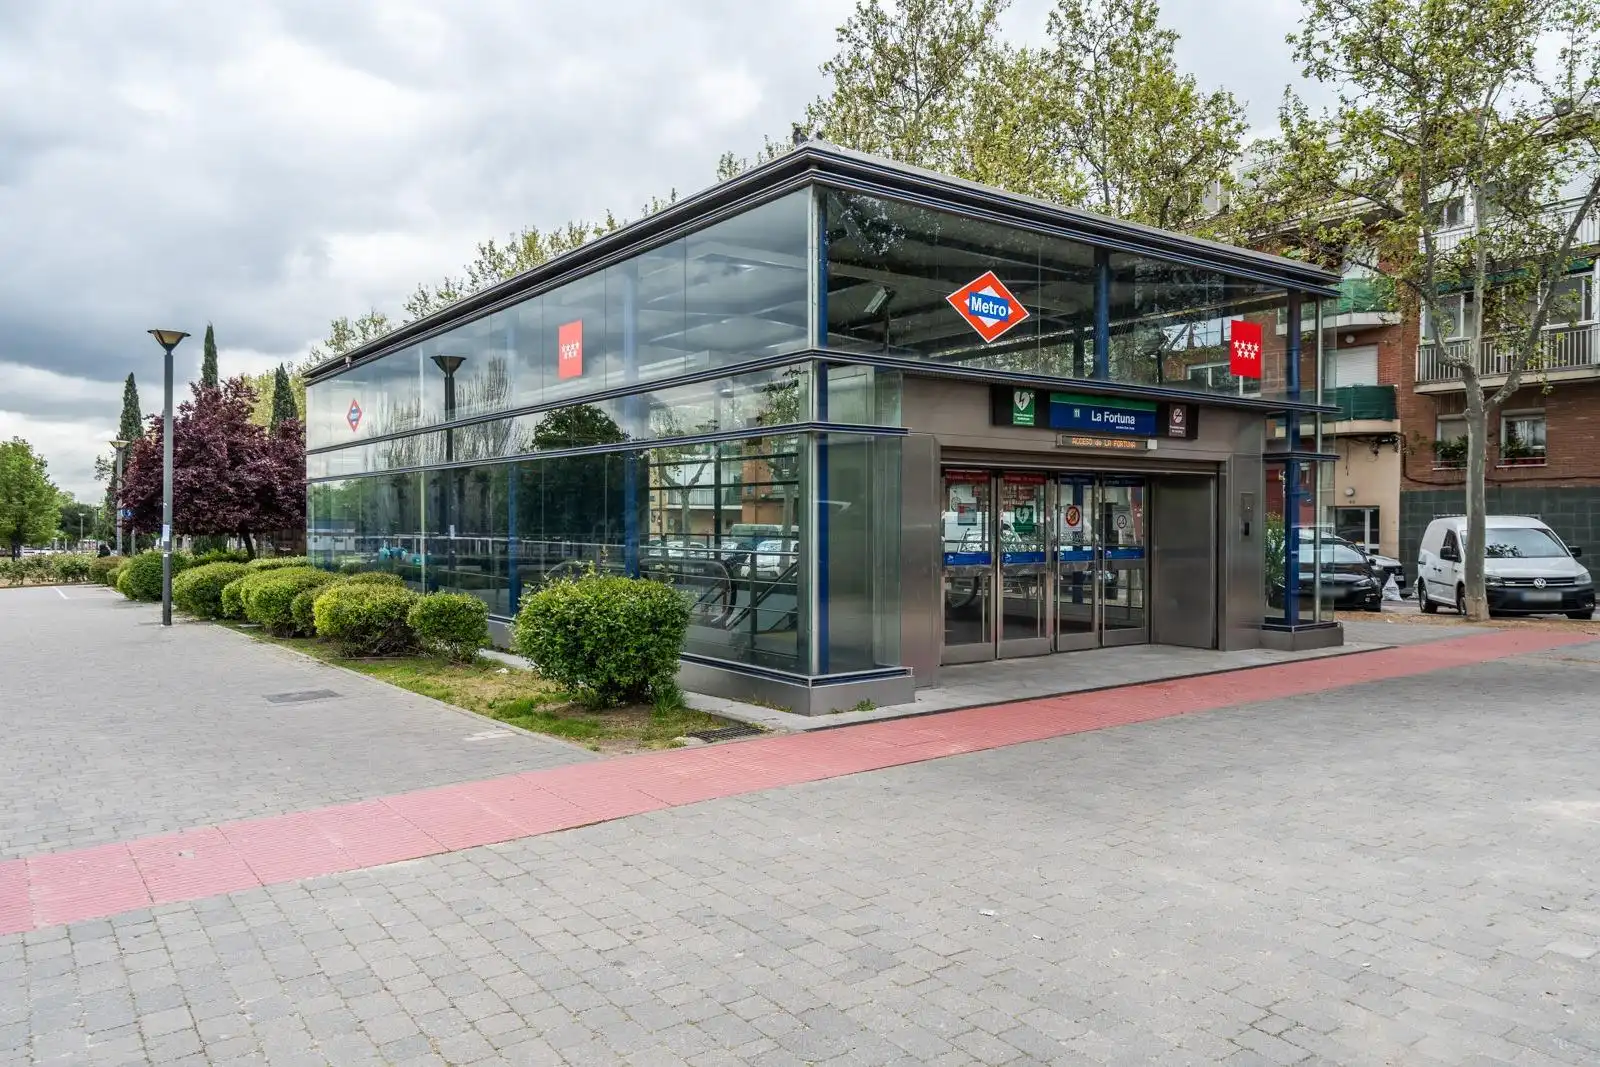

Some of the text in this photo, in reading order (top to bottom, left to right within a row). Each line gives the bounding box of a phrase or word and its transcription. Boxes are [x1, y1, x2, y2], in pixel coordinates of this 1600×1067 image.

[971, 295, 1007, 317] Metro
[1091, 410, 1136, 425] La Fortuna
[1072, 437, 1093, 446] ACCESO
[1113, 440, 1136, 449] FORTUNA
